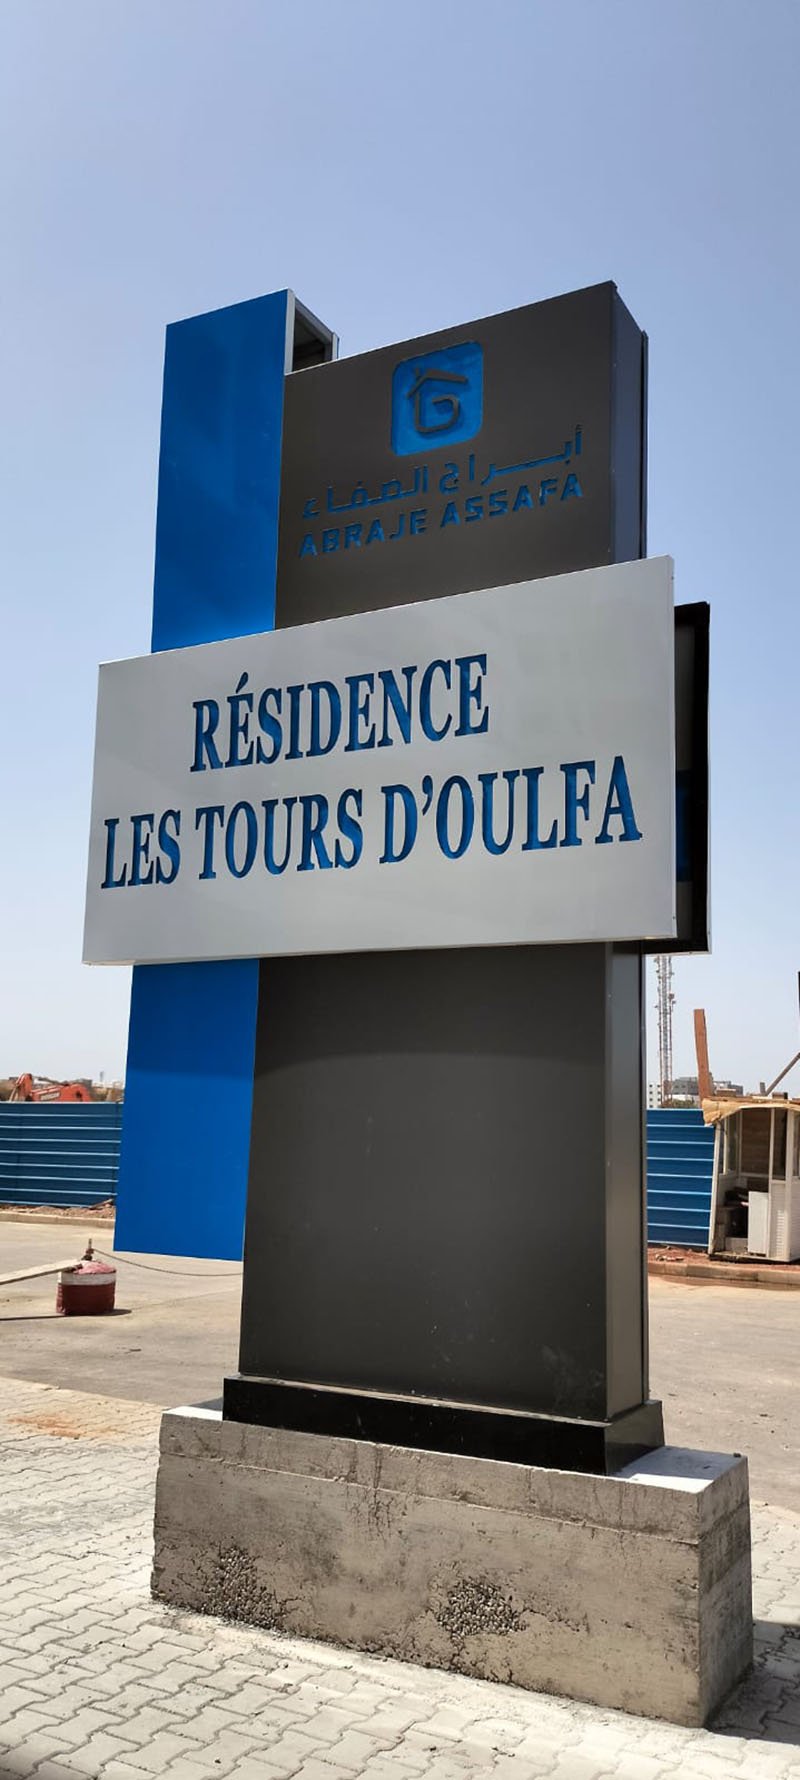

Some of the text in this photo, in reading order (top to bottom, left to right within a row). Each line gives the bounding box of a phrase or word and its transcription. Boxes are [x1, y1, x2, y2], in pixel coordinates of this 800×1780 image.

[300, 473, 583, 558] ABRAJE ASSAFA
[302, 424, 583, 519] أبراج الصفاء
[190, 653, 489, 772] RÉSIDENCE
[100, 755, 642, 889] LES TOURS D’OULFA
